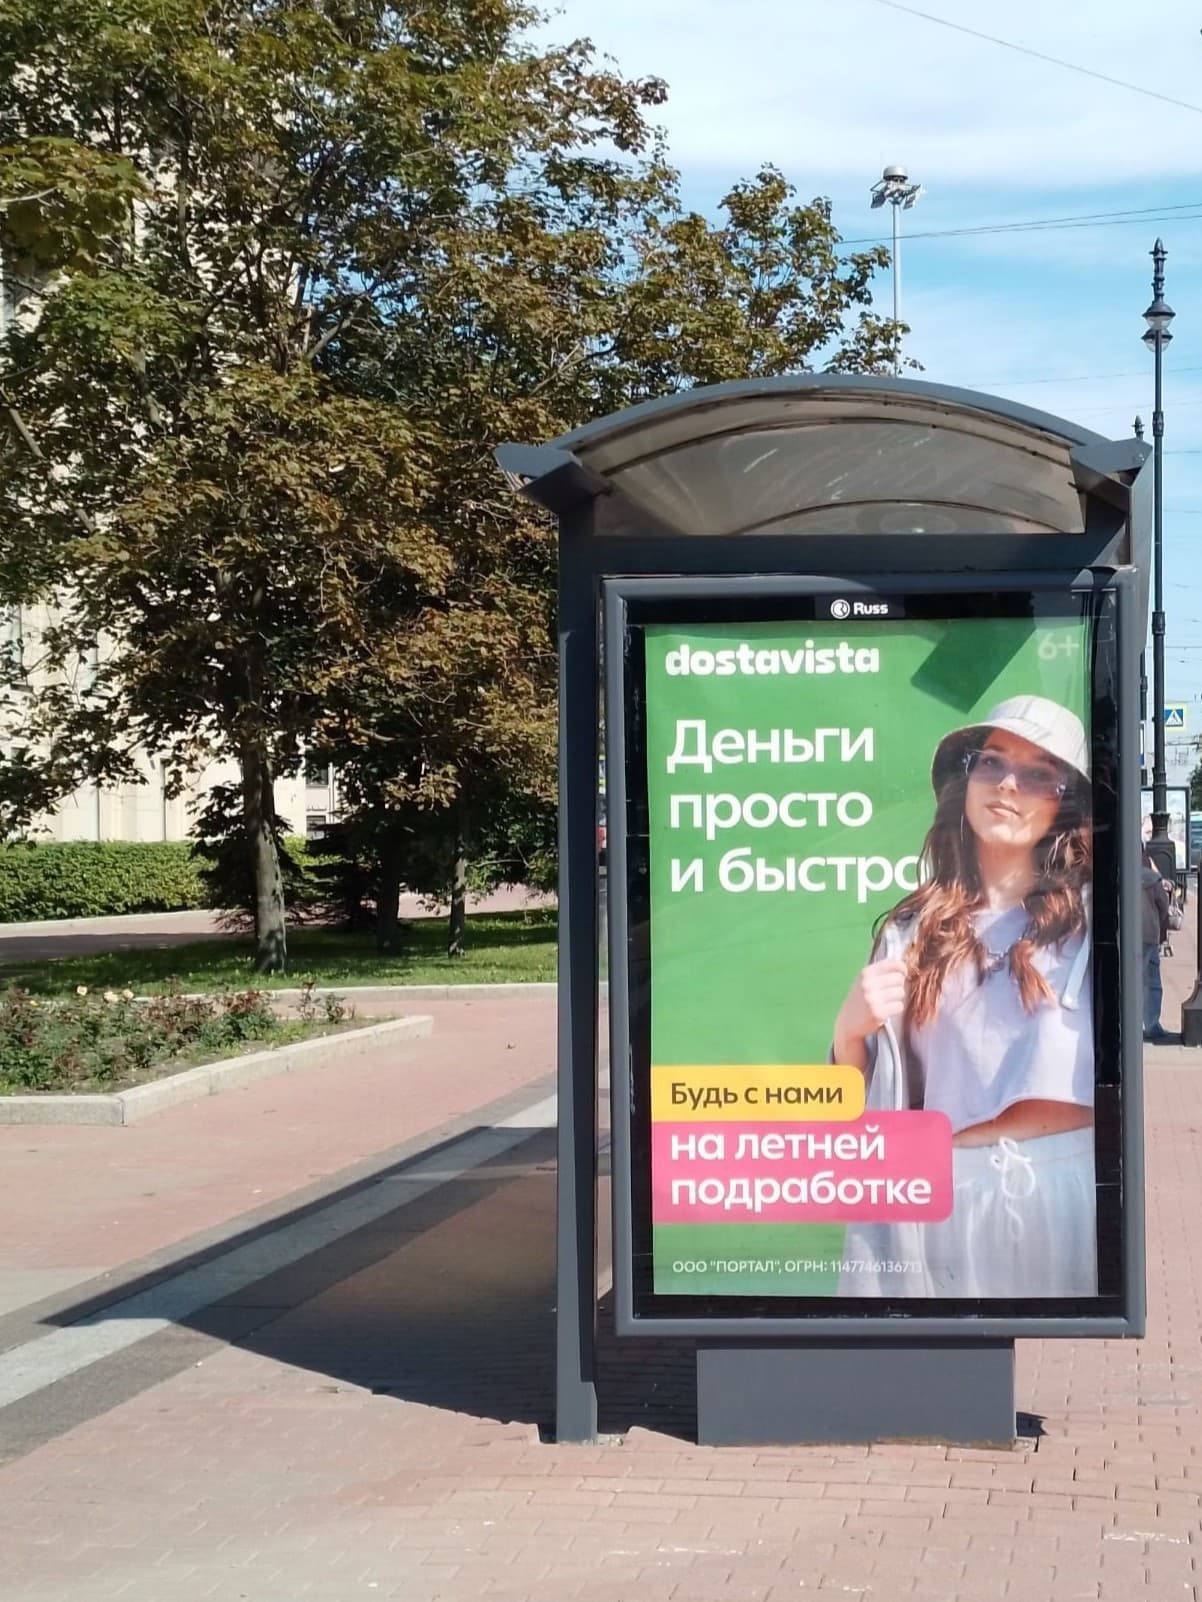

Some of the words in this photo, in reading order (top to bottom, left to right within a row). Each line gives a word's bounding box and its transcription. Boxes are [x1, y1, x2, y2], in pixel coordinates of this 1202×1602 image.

[853, 602, 889, 615] Russ
[665, 640, 880, 676] dostavista
[1037, 632, 1080, 660] 6+
[666, 719, 875, 773] Деньги
[670, 791, 873, 840] просто
[671, 858, 704, 892] и
[718, 847, 932, 903] быстро
[671, 1083, 738, 1109] Будь
[744, 1088, 759, 1105] с
[766, 1088, 844, 1105] нами
[671, 1133, 725, 1160] на
[734, 1125, 885, 1161] летней
[671, 1171, 932, 1213] подработке
[672, 1260, 707, 1273] ООО
[710, 1260, 782, 1275] "ПОРТАЛ",
[784, 1260, 828, 1273] ОГРН:
